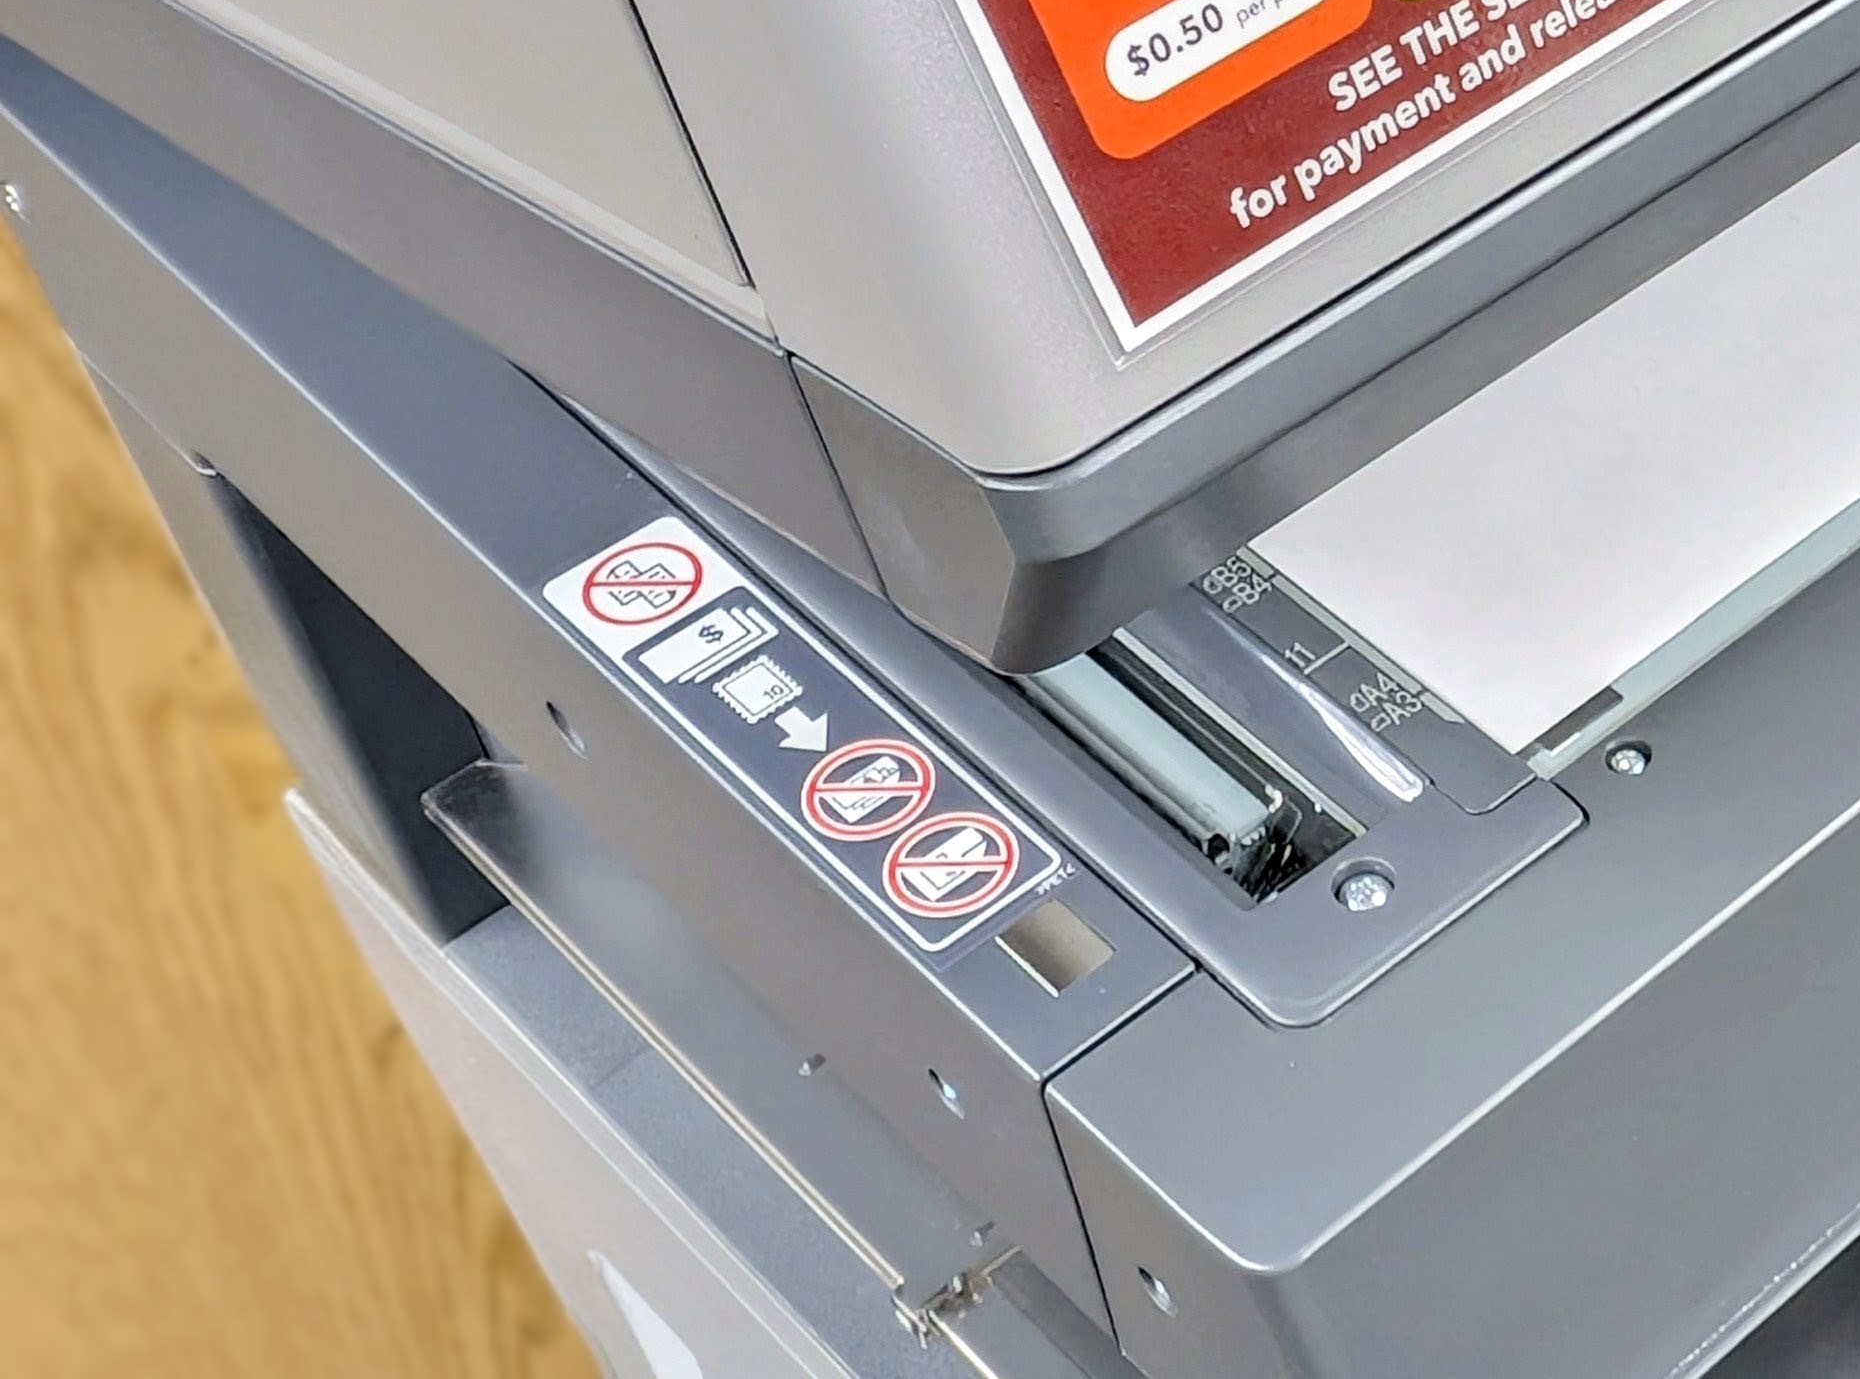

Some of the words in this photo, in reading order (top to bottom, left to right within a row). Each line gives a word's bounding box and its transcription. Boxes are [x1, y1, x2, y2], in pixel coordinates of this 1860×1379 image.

[1127, 3, 1224, 76] $0.50
[1236, 0, 1267, 27] per
[1327, 43, 1403, 111] SEE
[1229, 171, 1287, 229] for
[1293, 70, 1456, 200] payment
[1459, 31, 1526, 92] and
[1285, 642, 1316, 667] 11
[1359, 672, 1401, 708] A4
[1385, 691, 1422, 726] A3
